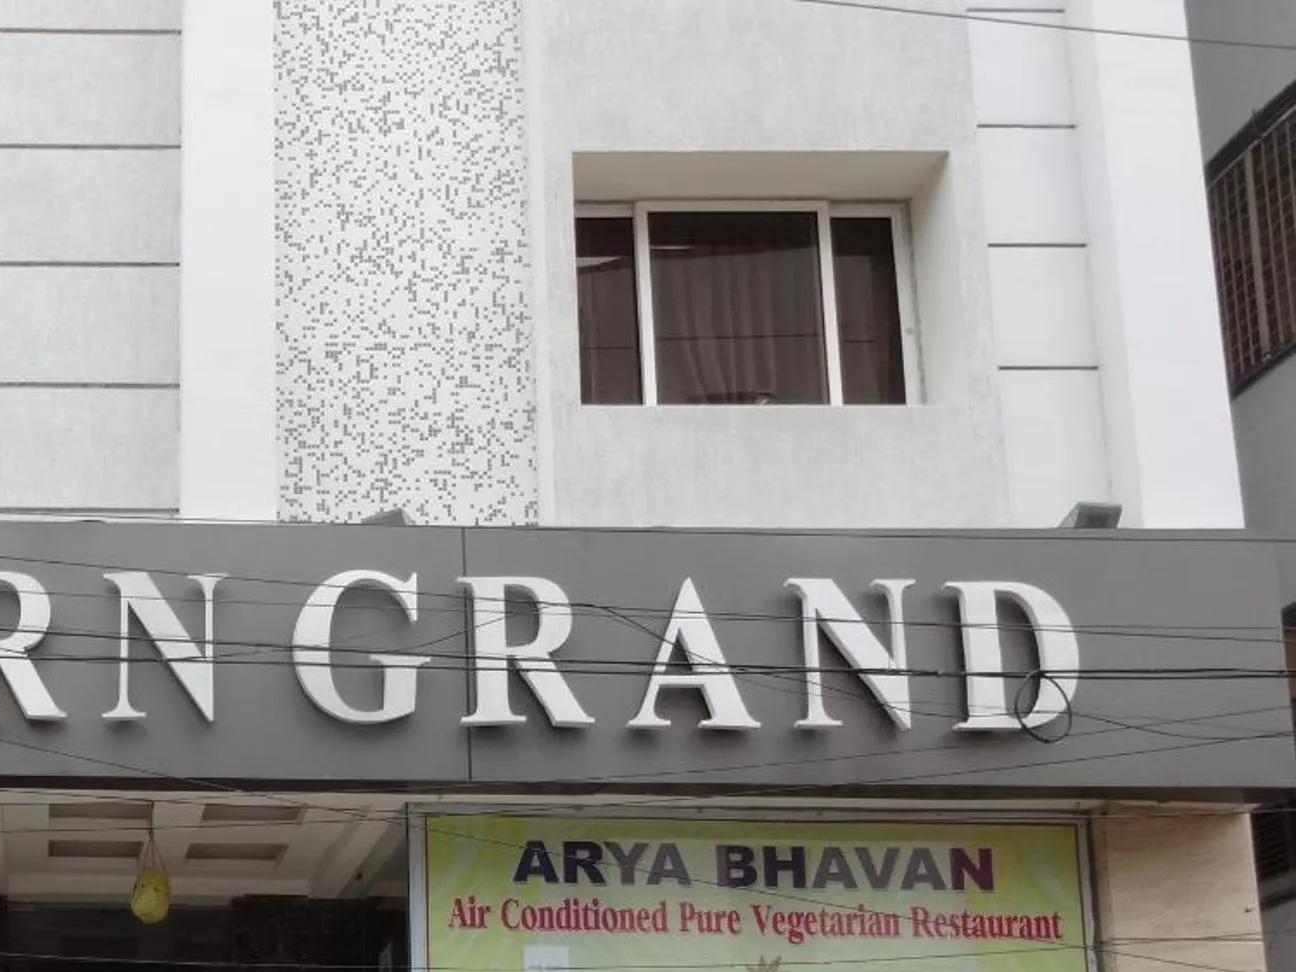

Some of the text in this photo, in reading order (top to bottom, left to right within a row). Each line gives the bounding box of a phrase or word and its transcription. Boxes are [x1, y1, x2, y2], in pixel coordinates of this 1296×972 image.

[292, 569, 1081, 731] GRAND
[513, 839, 995, 892] ARYA BHAVAN
[449, 896, 1063, 944] Air Conditioned Pure Vegetarian Restaurant
